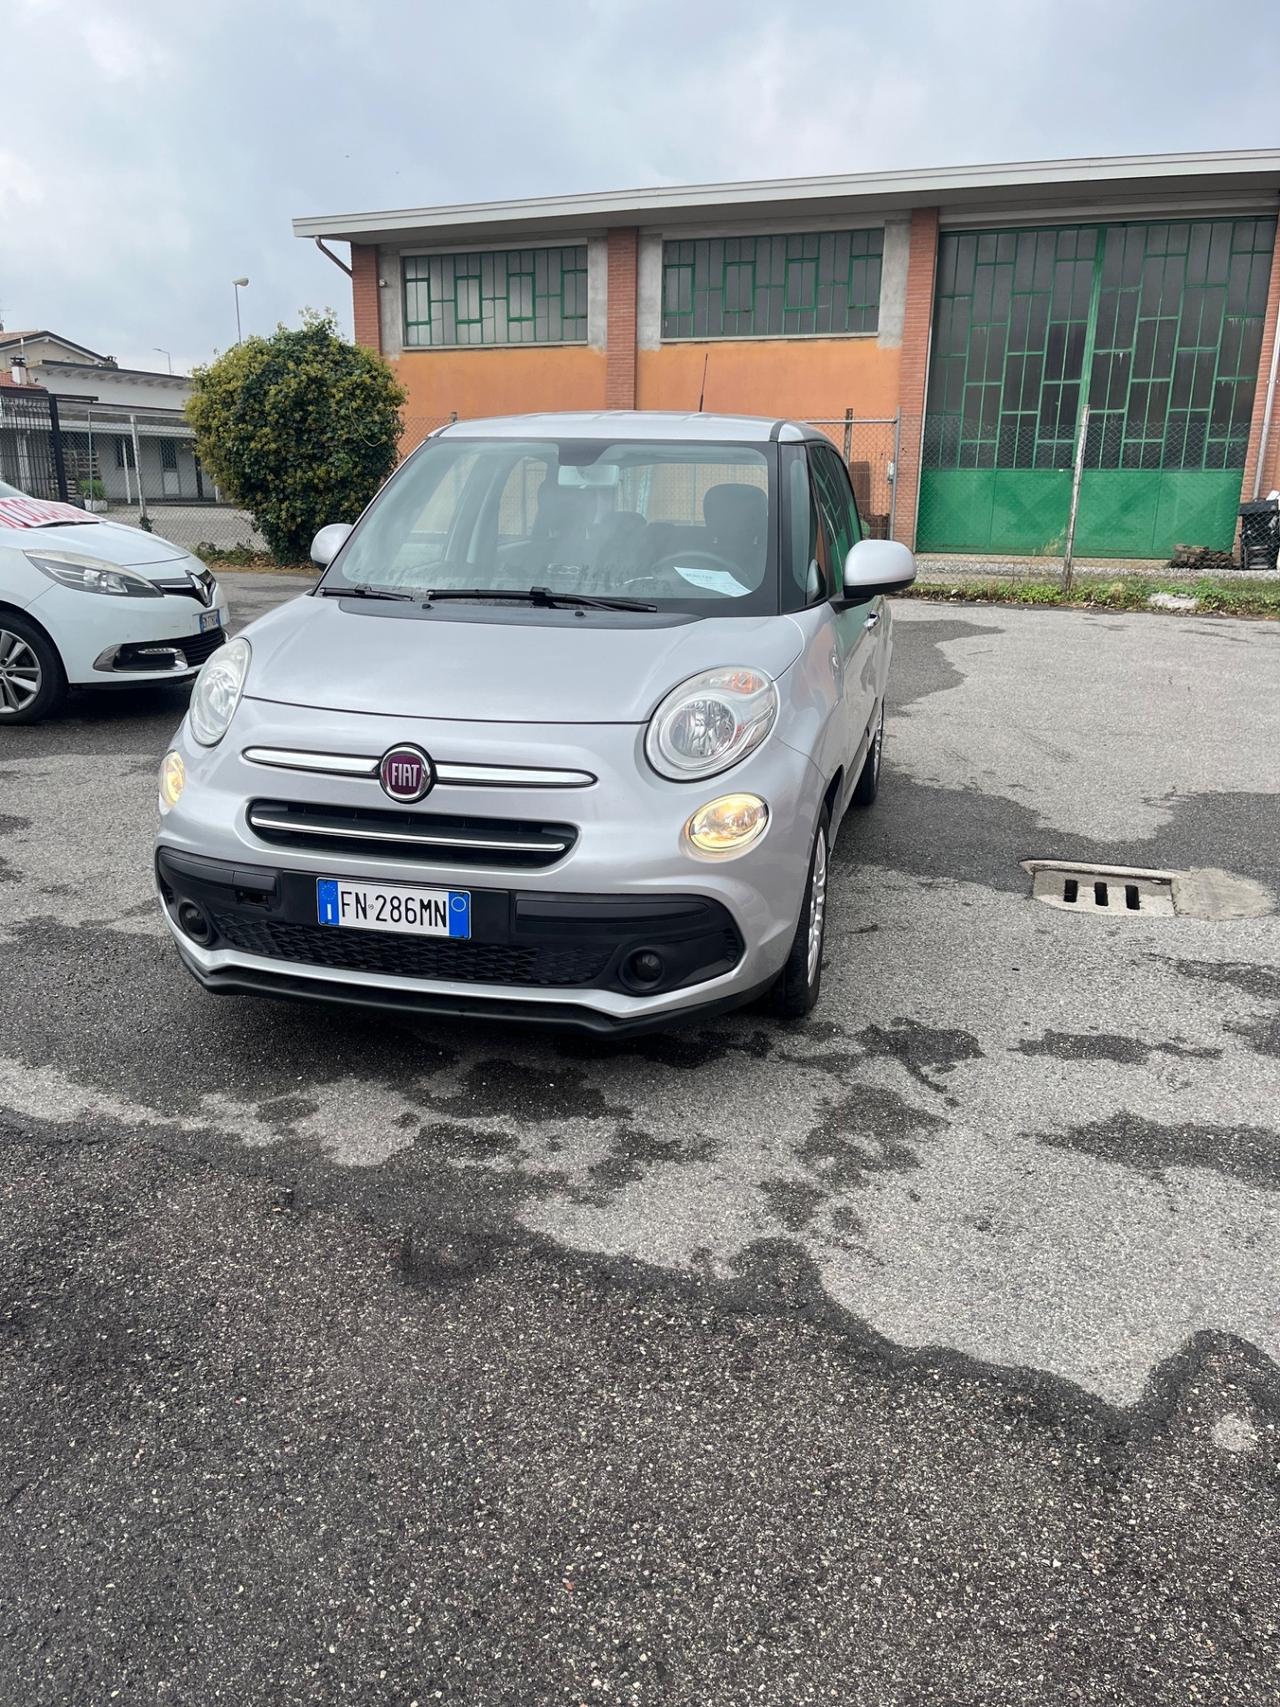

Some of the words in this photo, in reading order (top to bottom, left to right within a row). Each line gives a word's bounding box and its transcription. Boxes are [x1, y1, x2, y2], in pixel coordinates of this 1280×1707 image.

[391, 763, 420, 787] FIAT
[340, 890, 368, 920] FN
[375, 894, 448, 928] 286MN
